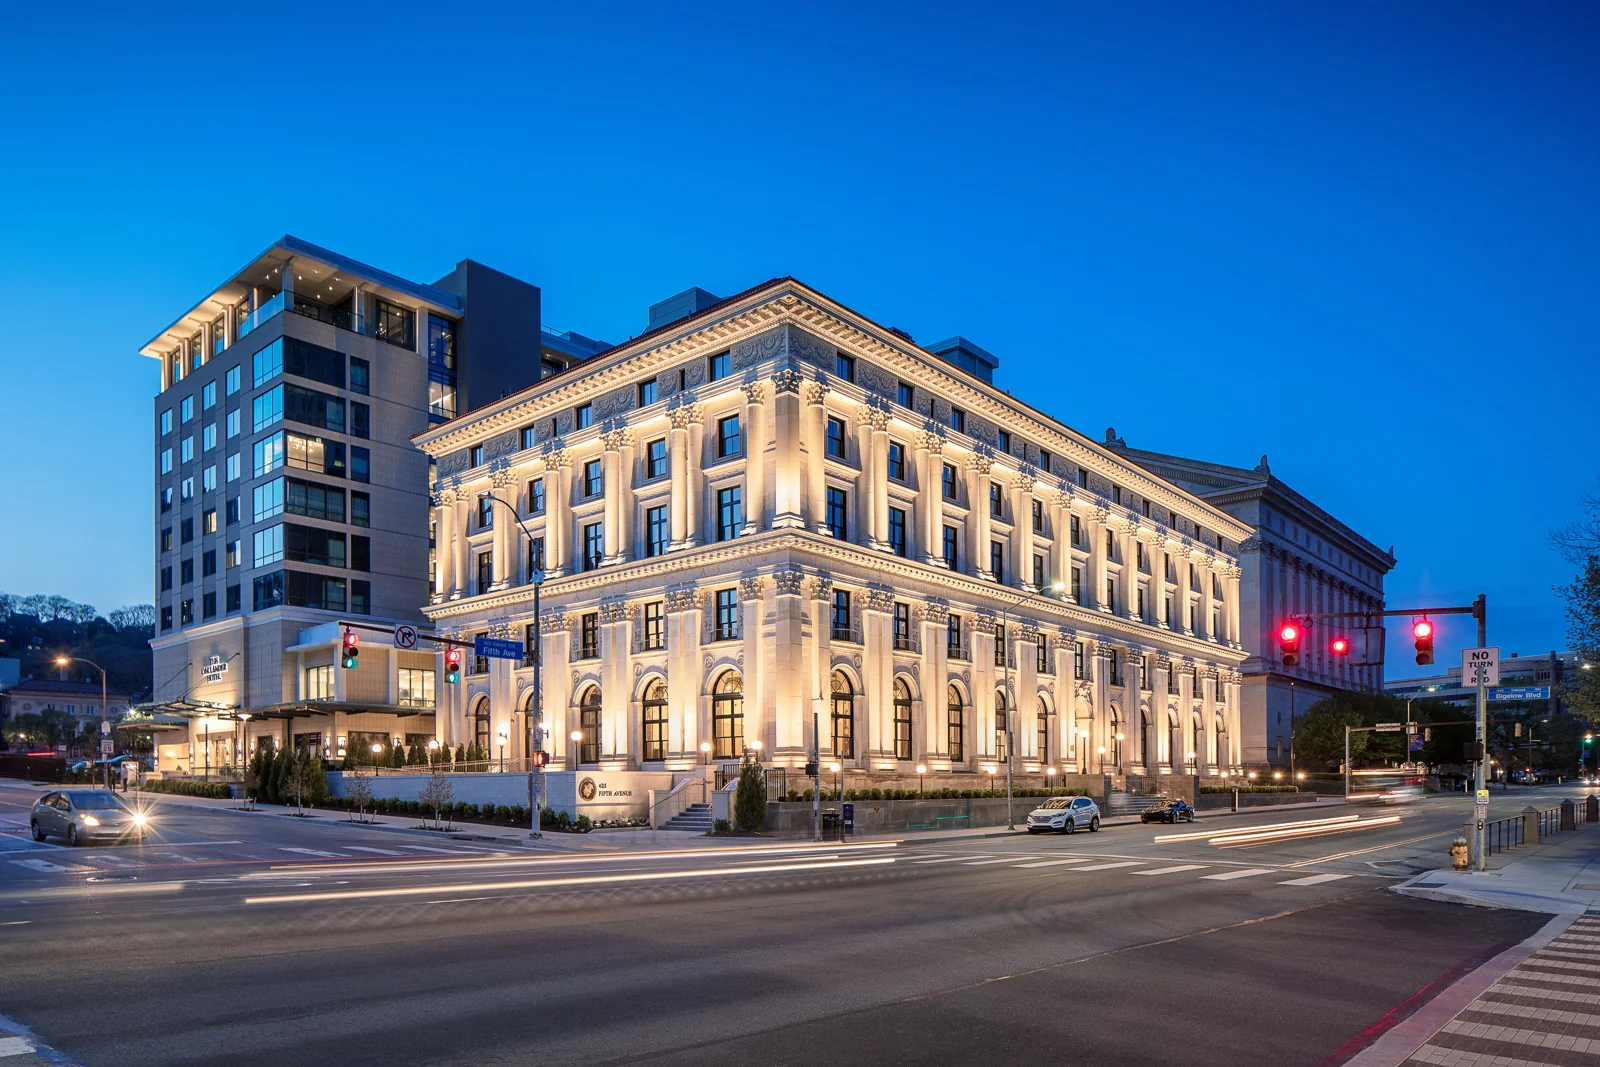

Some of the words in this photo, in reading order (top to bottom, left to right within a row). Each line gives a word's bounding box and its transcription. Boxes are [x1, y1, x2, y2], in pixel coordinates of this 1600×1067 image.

[483, 646, 500, 656] Fifth
[502, 649, 516, 658] Ave
[1472, 651, 1489, 660] NO
